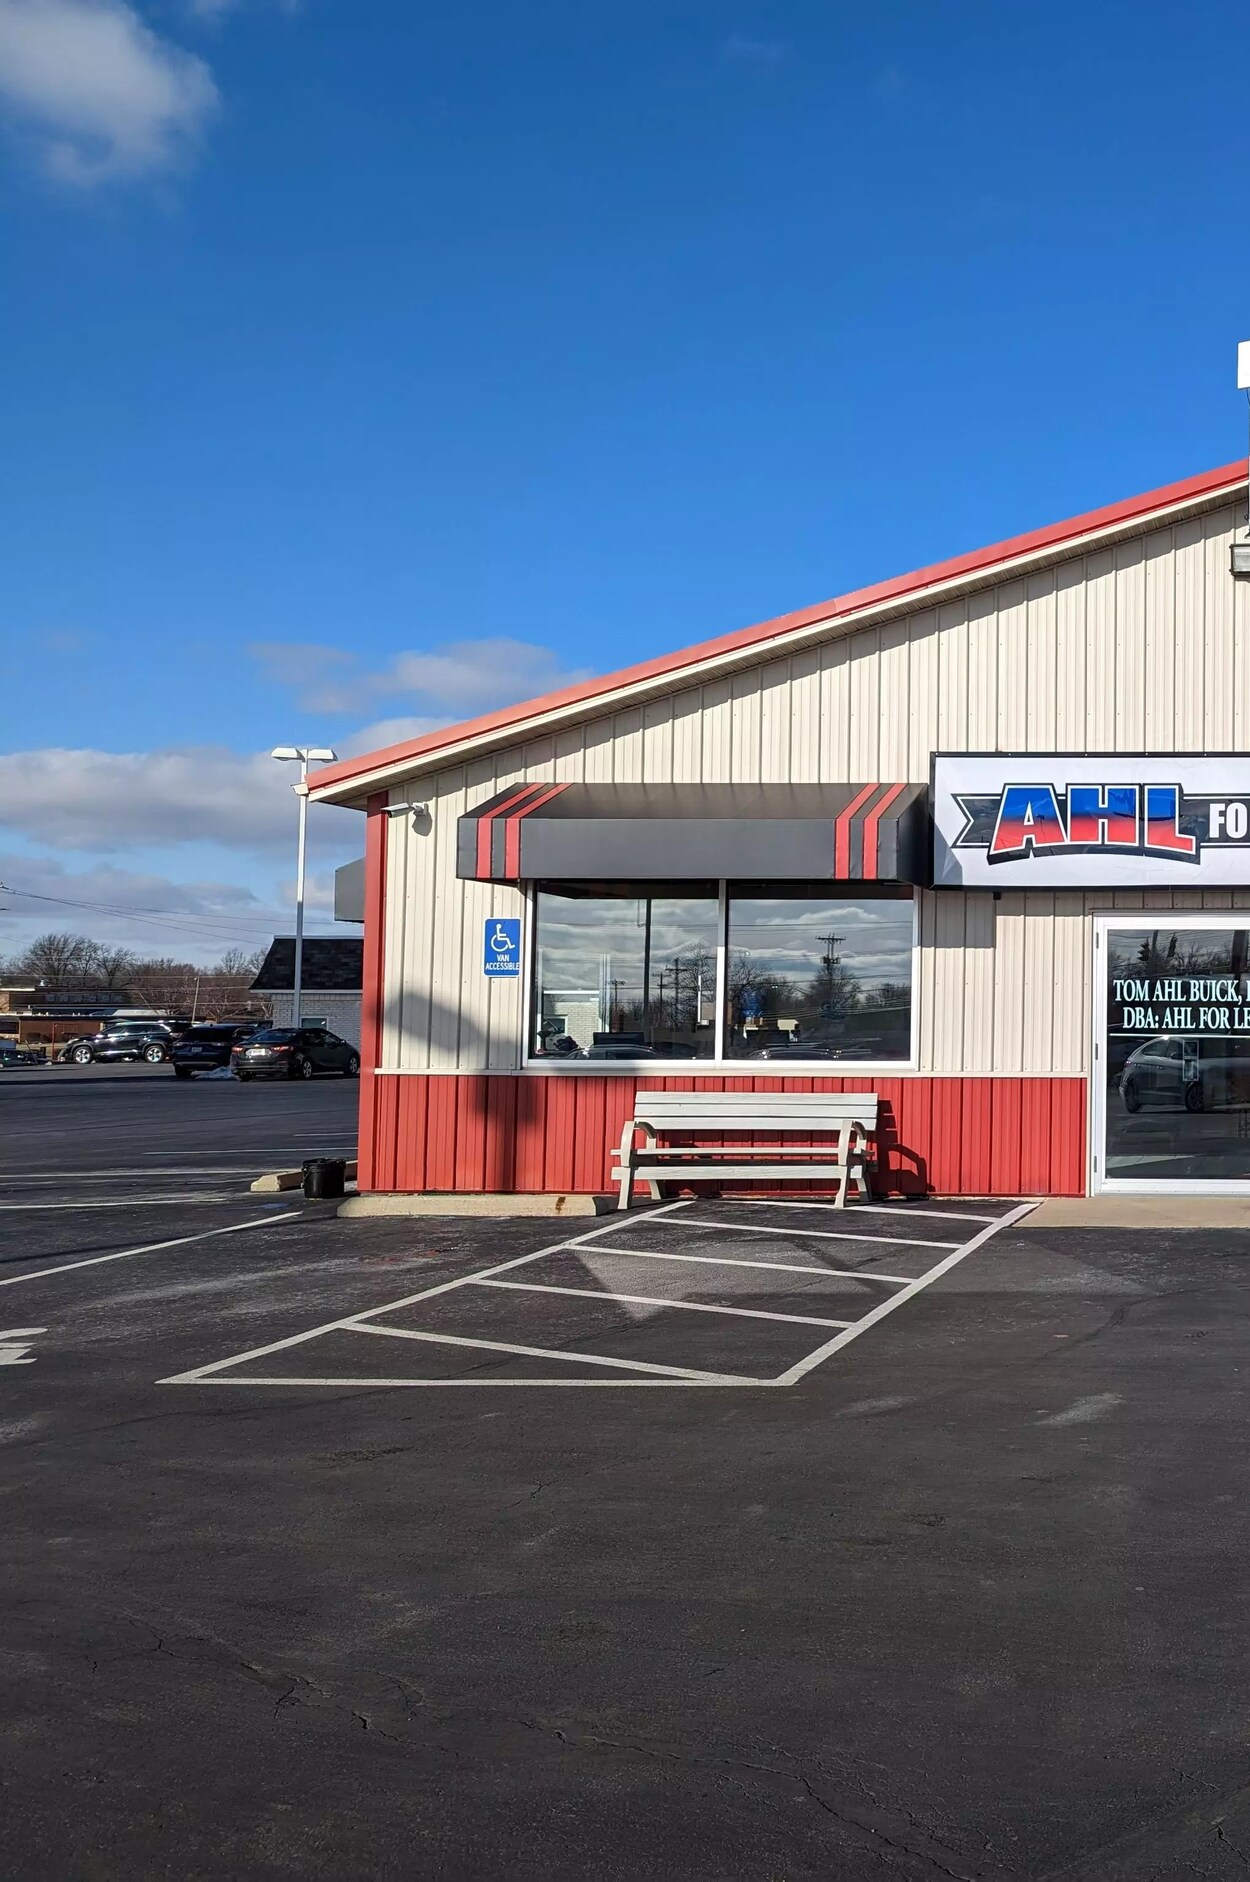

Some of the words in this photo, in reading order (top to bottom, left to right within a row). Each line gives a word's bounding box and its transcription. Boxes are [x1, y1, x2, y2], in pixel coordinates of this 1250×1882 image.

[989, 782, 1200, 863] AHL
[485, 962, 520, 971] ACCESSIBLE
[496, 954, 510, 962] VAN
[1112, 979, 1149, 1002] TOM
[1152, 979, 1187, 1002] AHL
[1189, 979, 1243, 1005] BUICK,
[1122, 1007, 1159, 1029] DBA:
[1161, 1007, 1196, 1029] AHL
[1200, 1007, 1232, 1029] FOR
